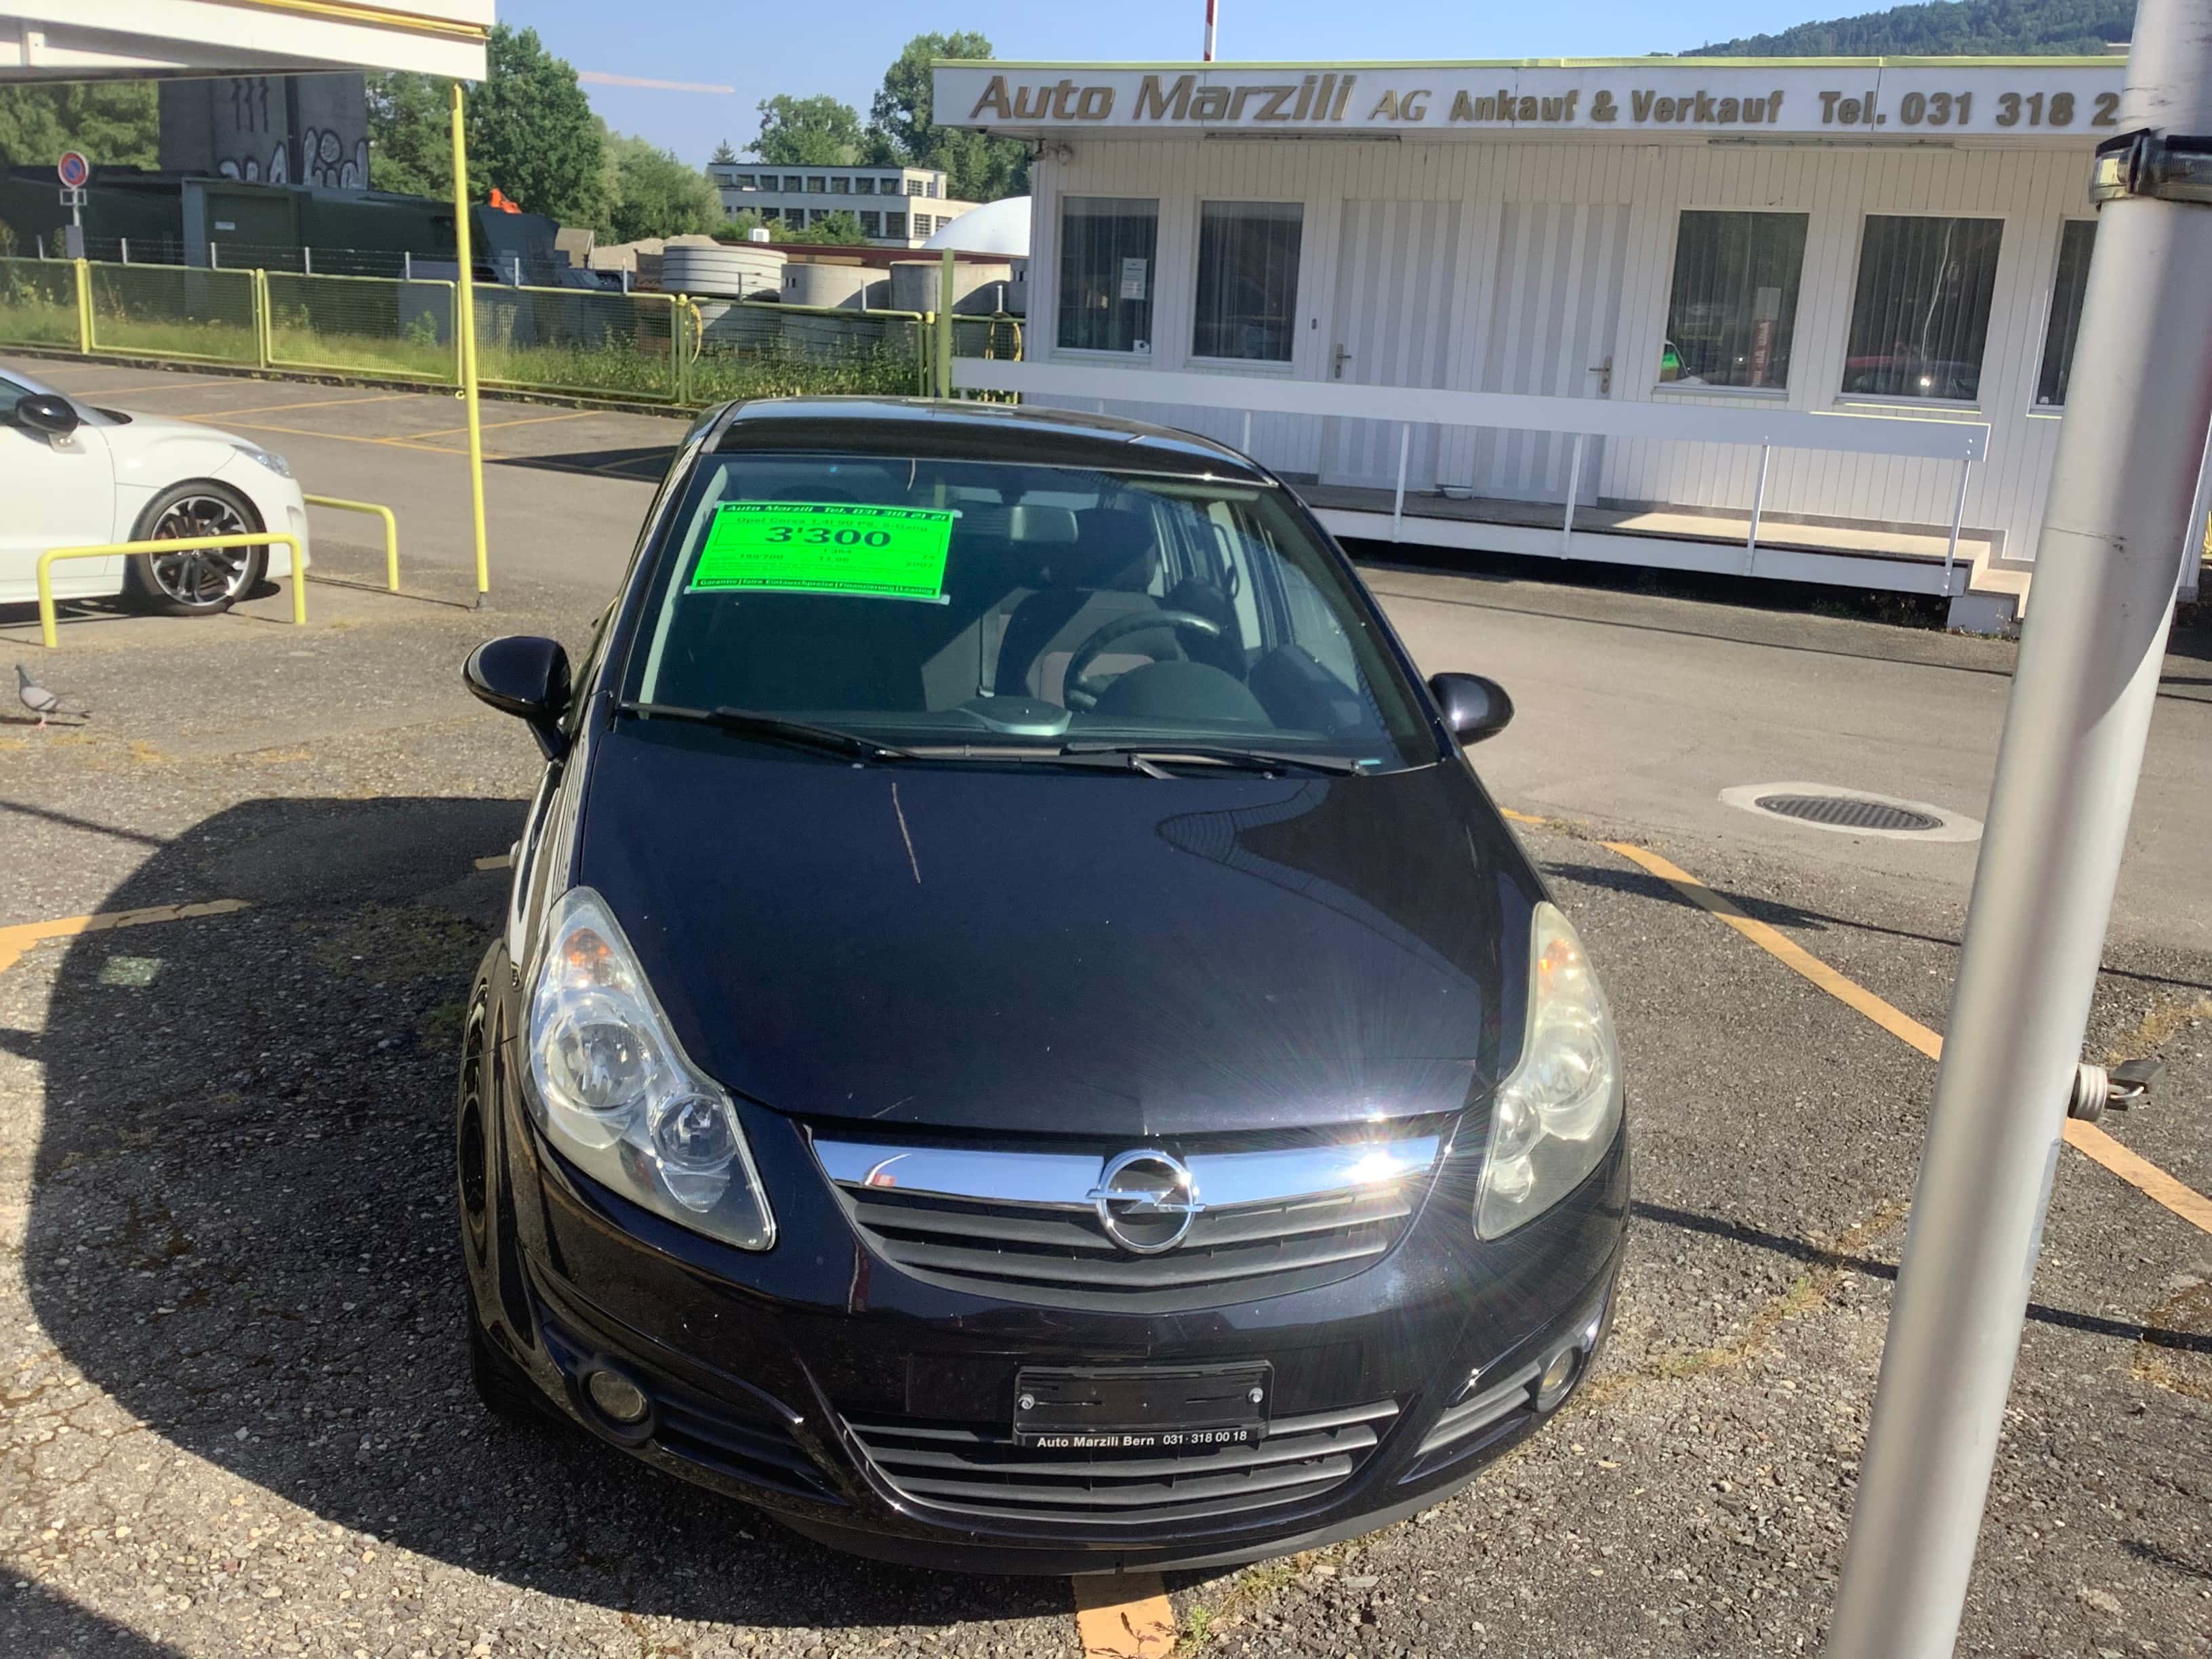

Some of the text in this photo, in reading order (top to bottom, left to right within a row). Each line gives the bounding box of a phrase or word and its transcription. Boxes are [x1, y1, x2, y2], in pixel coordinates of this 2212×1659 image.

[969, 75, 2121, 127] Auto Marzili AG Ankauf & Verkauf Tel. 031 318 2
[764, 526, 892, 548] 3'300
[1037, 1437, 1069, 1448] Auto
[1073, 1436, 1118, 1448] Marzili
[1122, 1436, 1155, 1447] Bern
[1215, 1431, 1230, 1442] 00
[1233, 1431, 1248, 1441] 18
